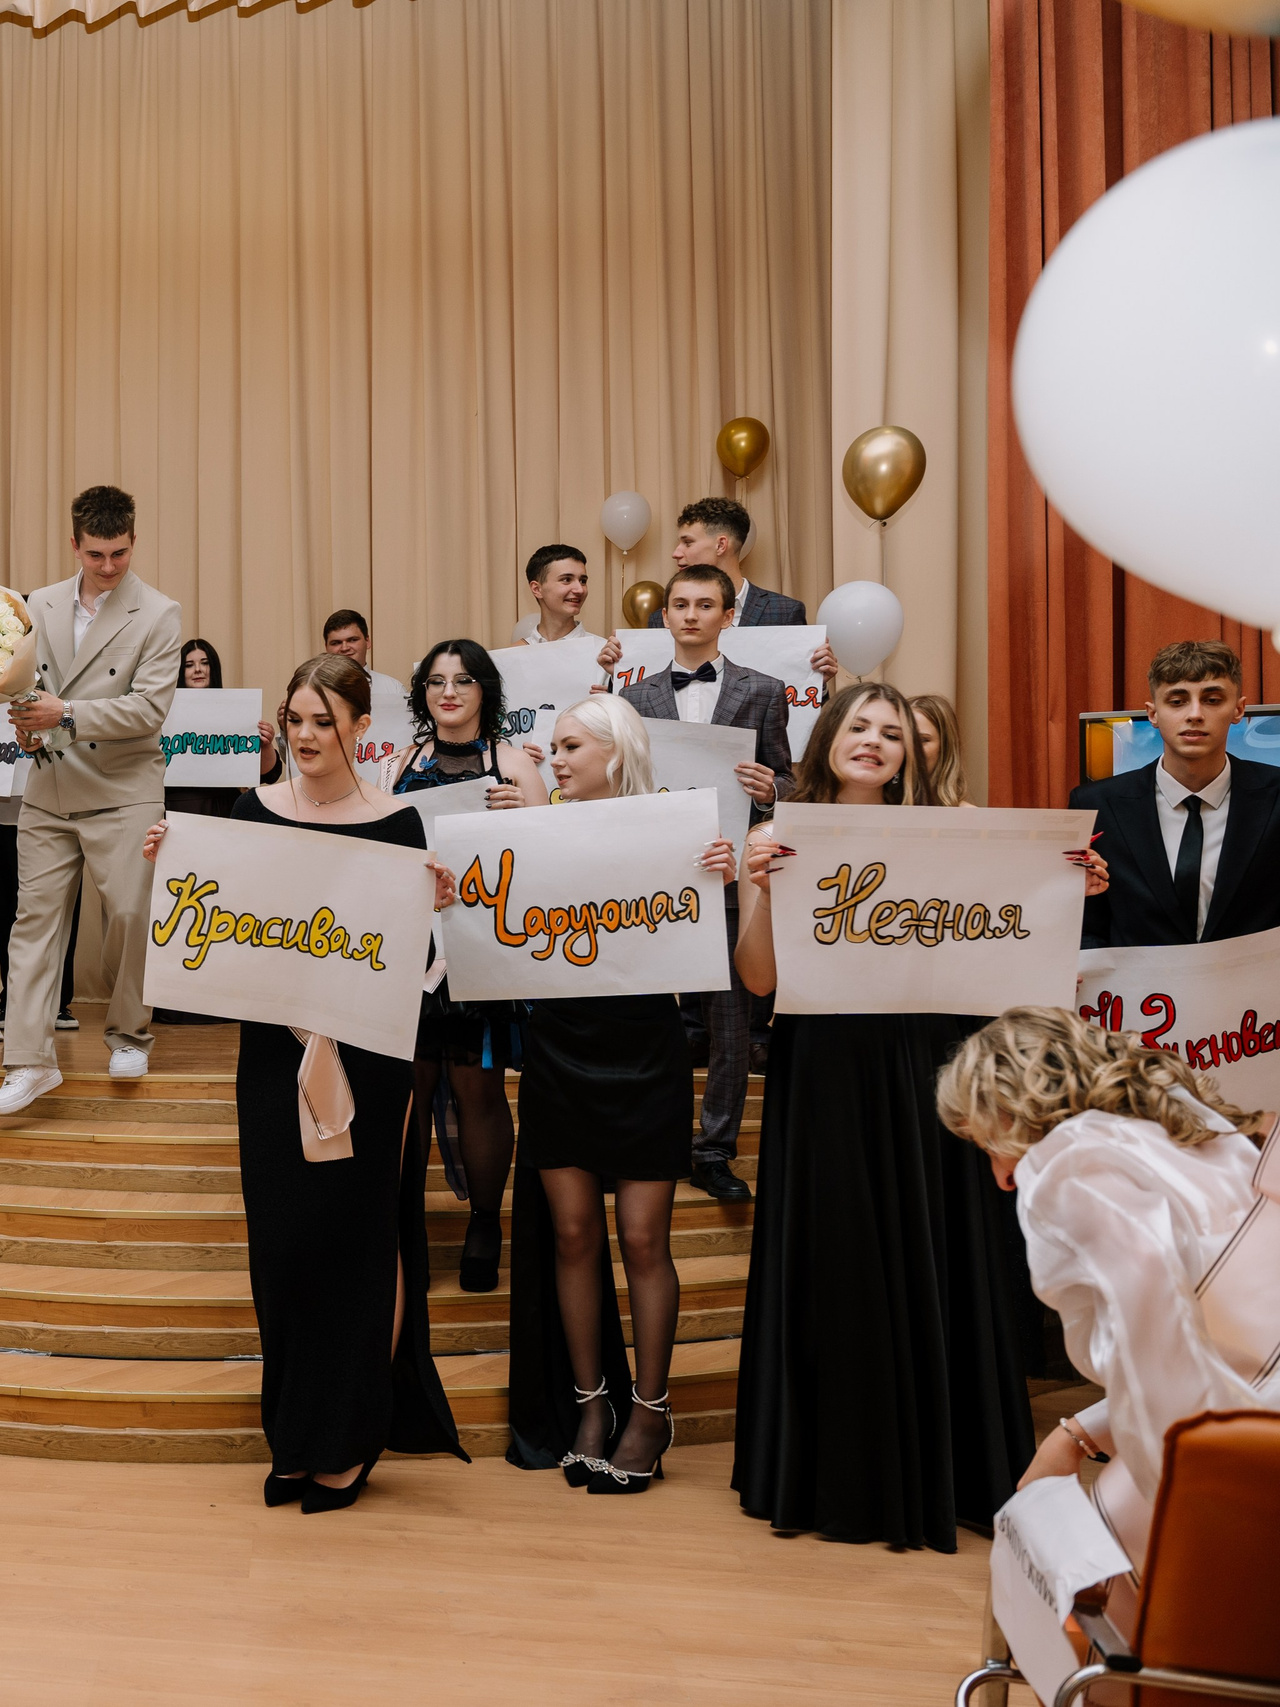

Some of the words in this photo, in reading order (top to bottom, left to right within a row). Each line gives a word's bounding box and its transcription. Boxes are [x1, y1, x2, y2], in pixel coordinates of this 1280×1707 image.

[159, 731, 261, 768] заменимая
[152, 872, 386, 971] Красивая
[459, 848, 701, 967] Чарующая
[813, 861, 1030, 947] Нежная
